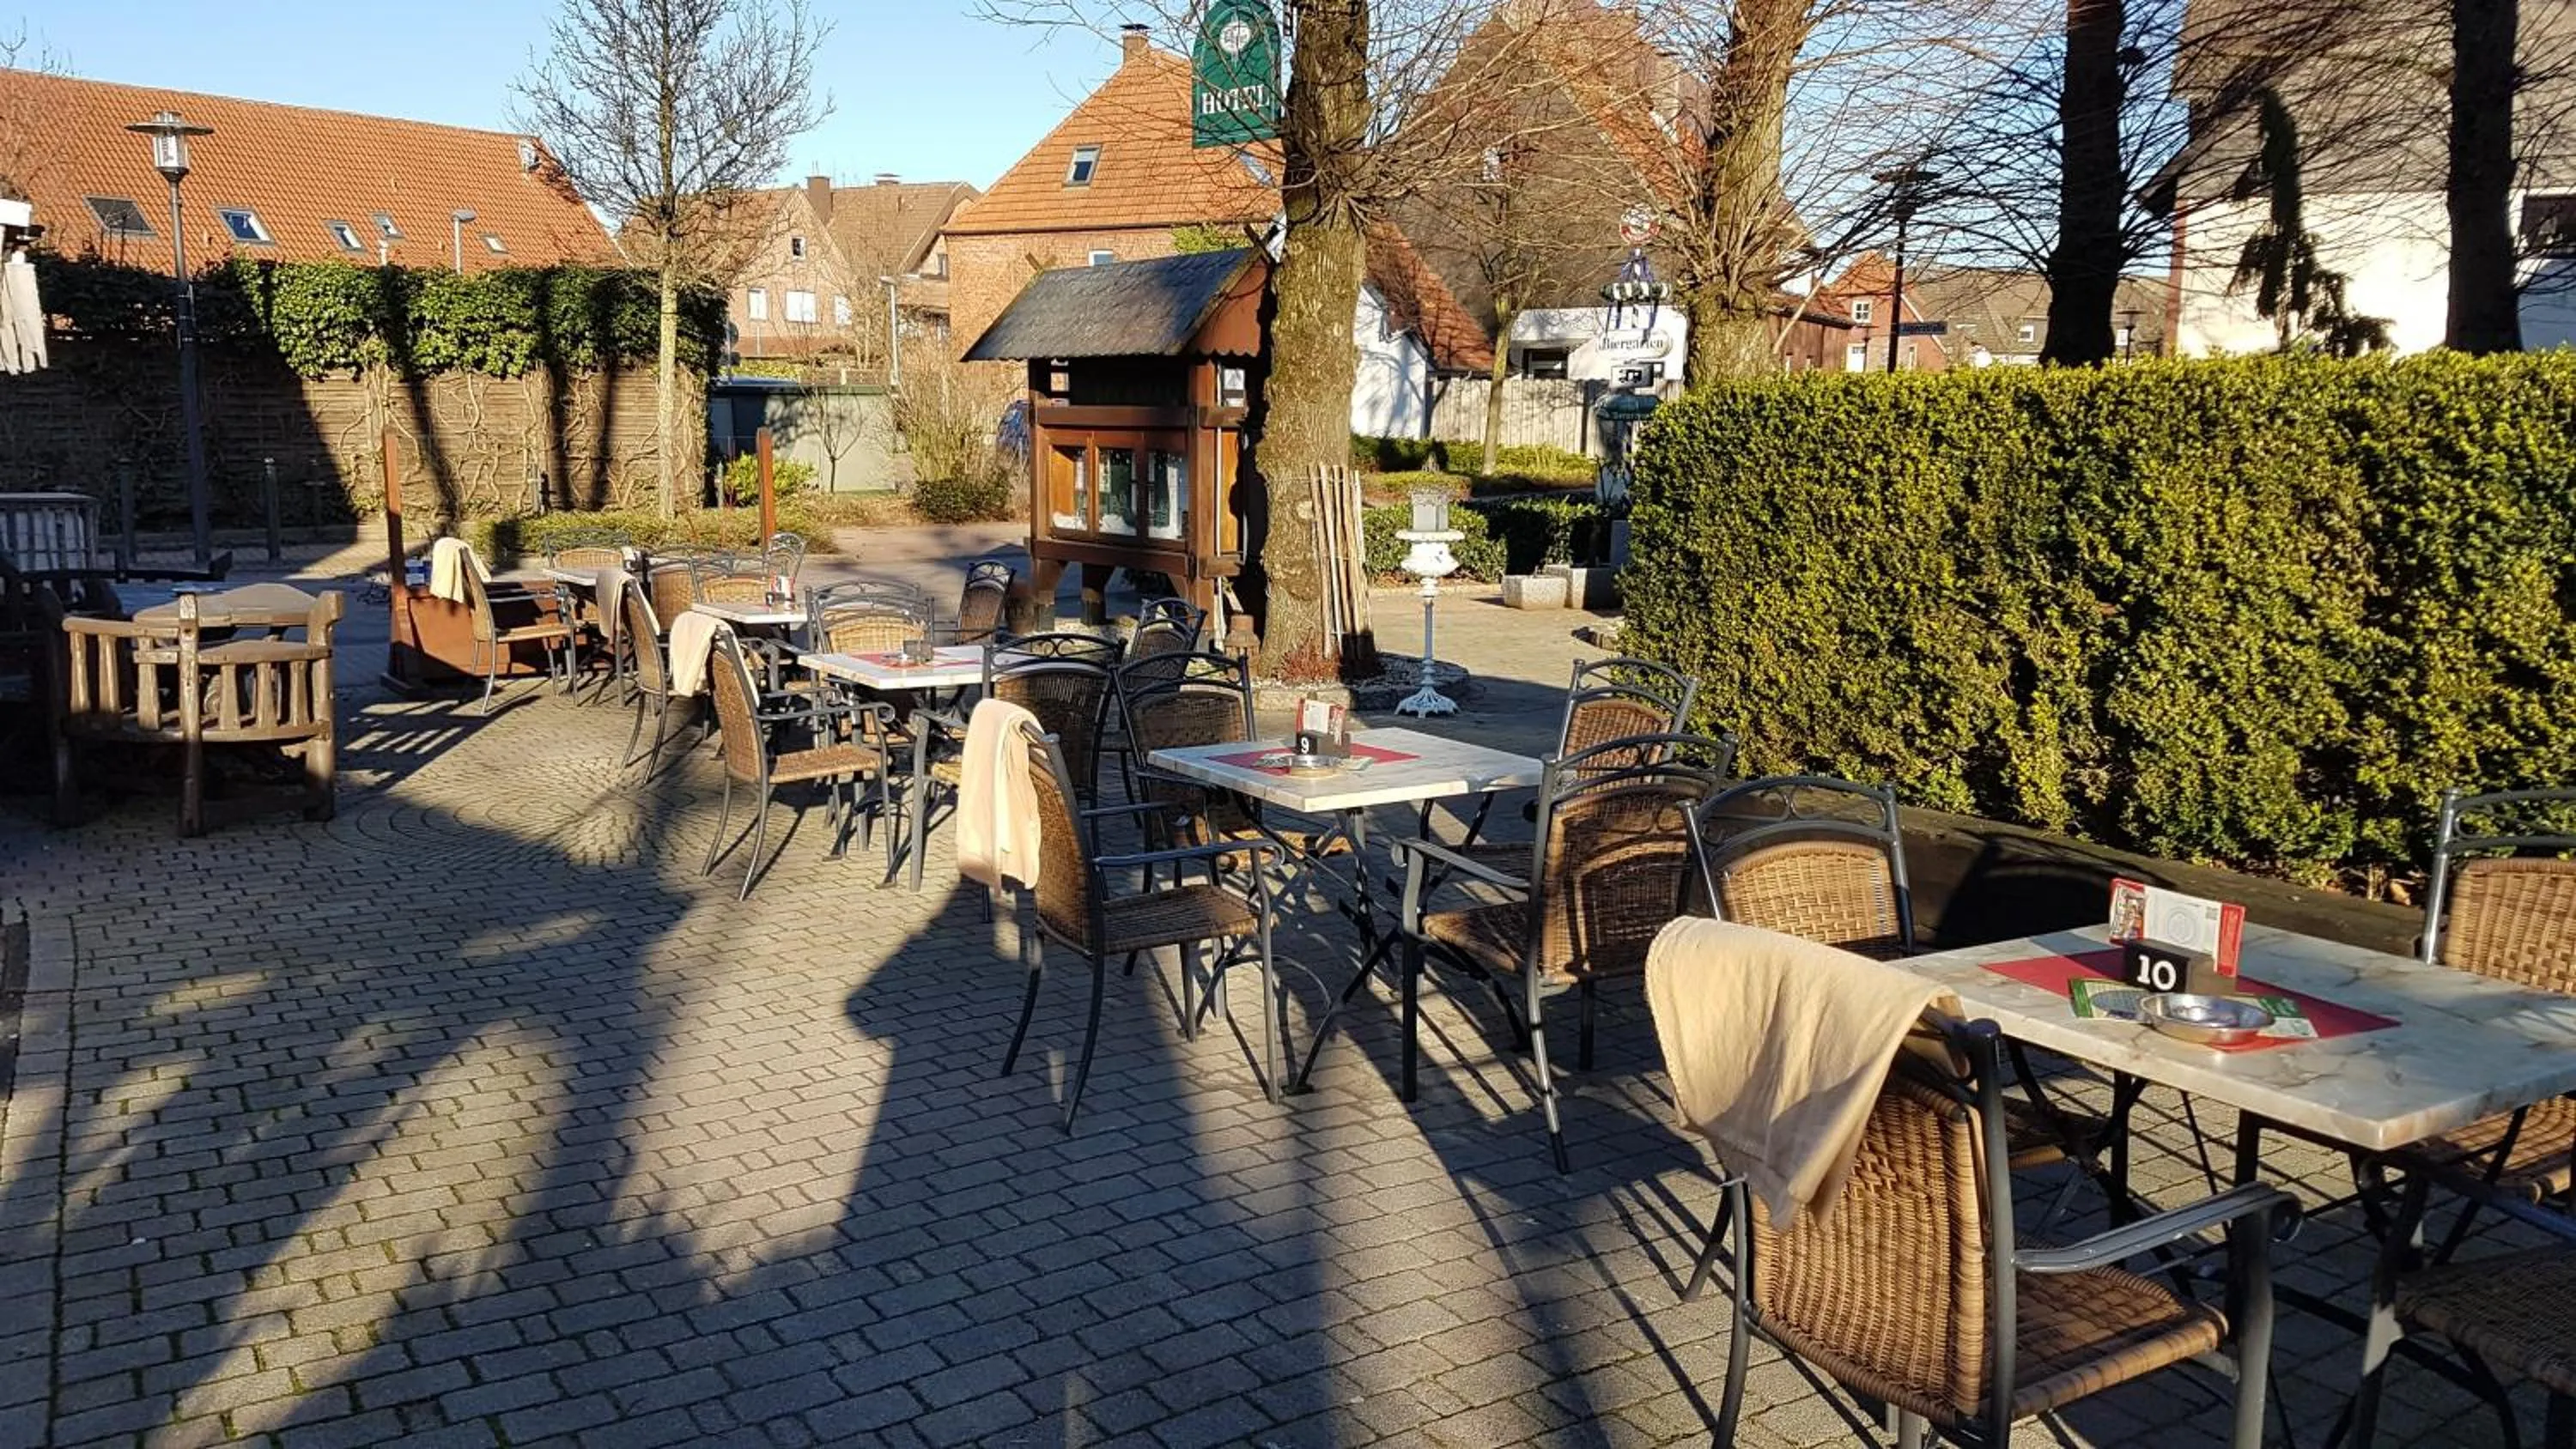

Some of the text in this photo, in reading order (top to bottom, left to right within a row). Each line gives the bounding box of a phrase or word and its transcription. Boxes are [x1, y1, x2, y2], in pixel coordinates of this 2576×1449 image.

[1201, 84, 1270, 114] HOTEL
[1301, 737, 1309, 754] 9
[2136, 955, 2177, 991] 10
